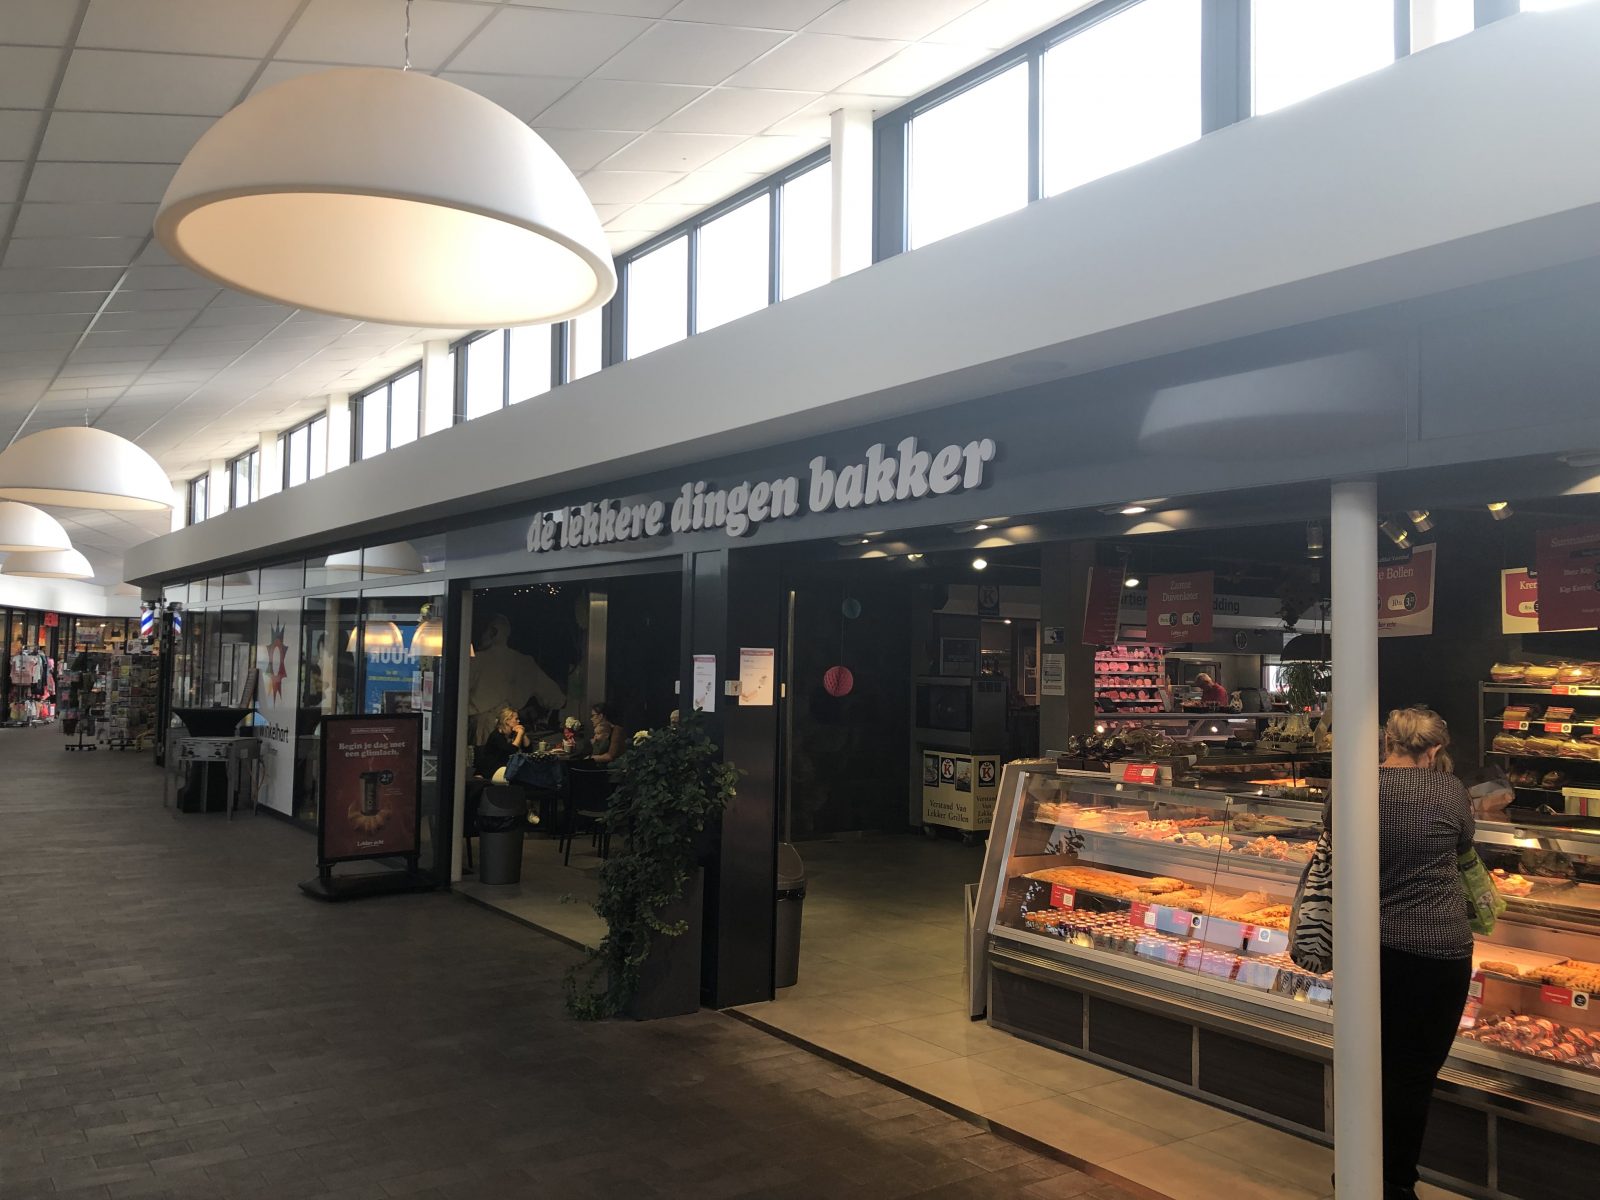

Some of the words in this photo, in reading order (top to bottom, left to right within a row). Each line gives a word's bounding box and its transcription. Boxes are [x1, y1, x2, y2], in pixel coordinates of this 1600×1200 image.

[526, 511, 554, 552] de
[560, 498, 664, 550] lekkere
[671, 480, 800, 537] dingen
[809, 436, 996, 513] bakker
[1386, 566, 1415, 579] Bollen
[338, 742, 363, 751] Begin
[364, 742, 372, 750] je
[373, 741, 389, 750] dag
[345, 750, 360, 758] een
[943, 763, 952, 776] K
[981, 767, 992, 779] K
[929, 799, 954, 811] Verstand
[955, 802, 967, 813] Van
[927, 808, 946, 820] Lekker
[948, 811, 969, 823] Grillen
